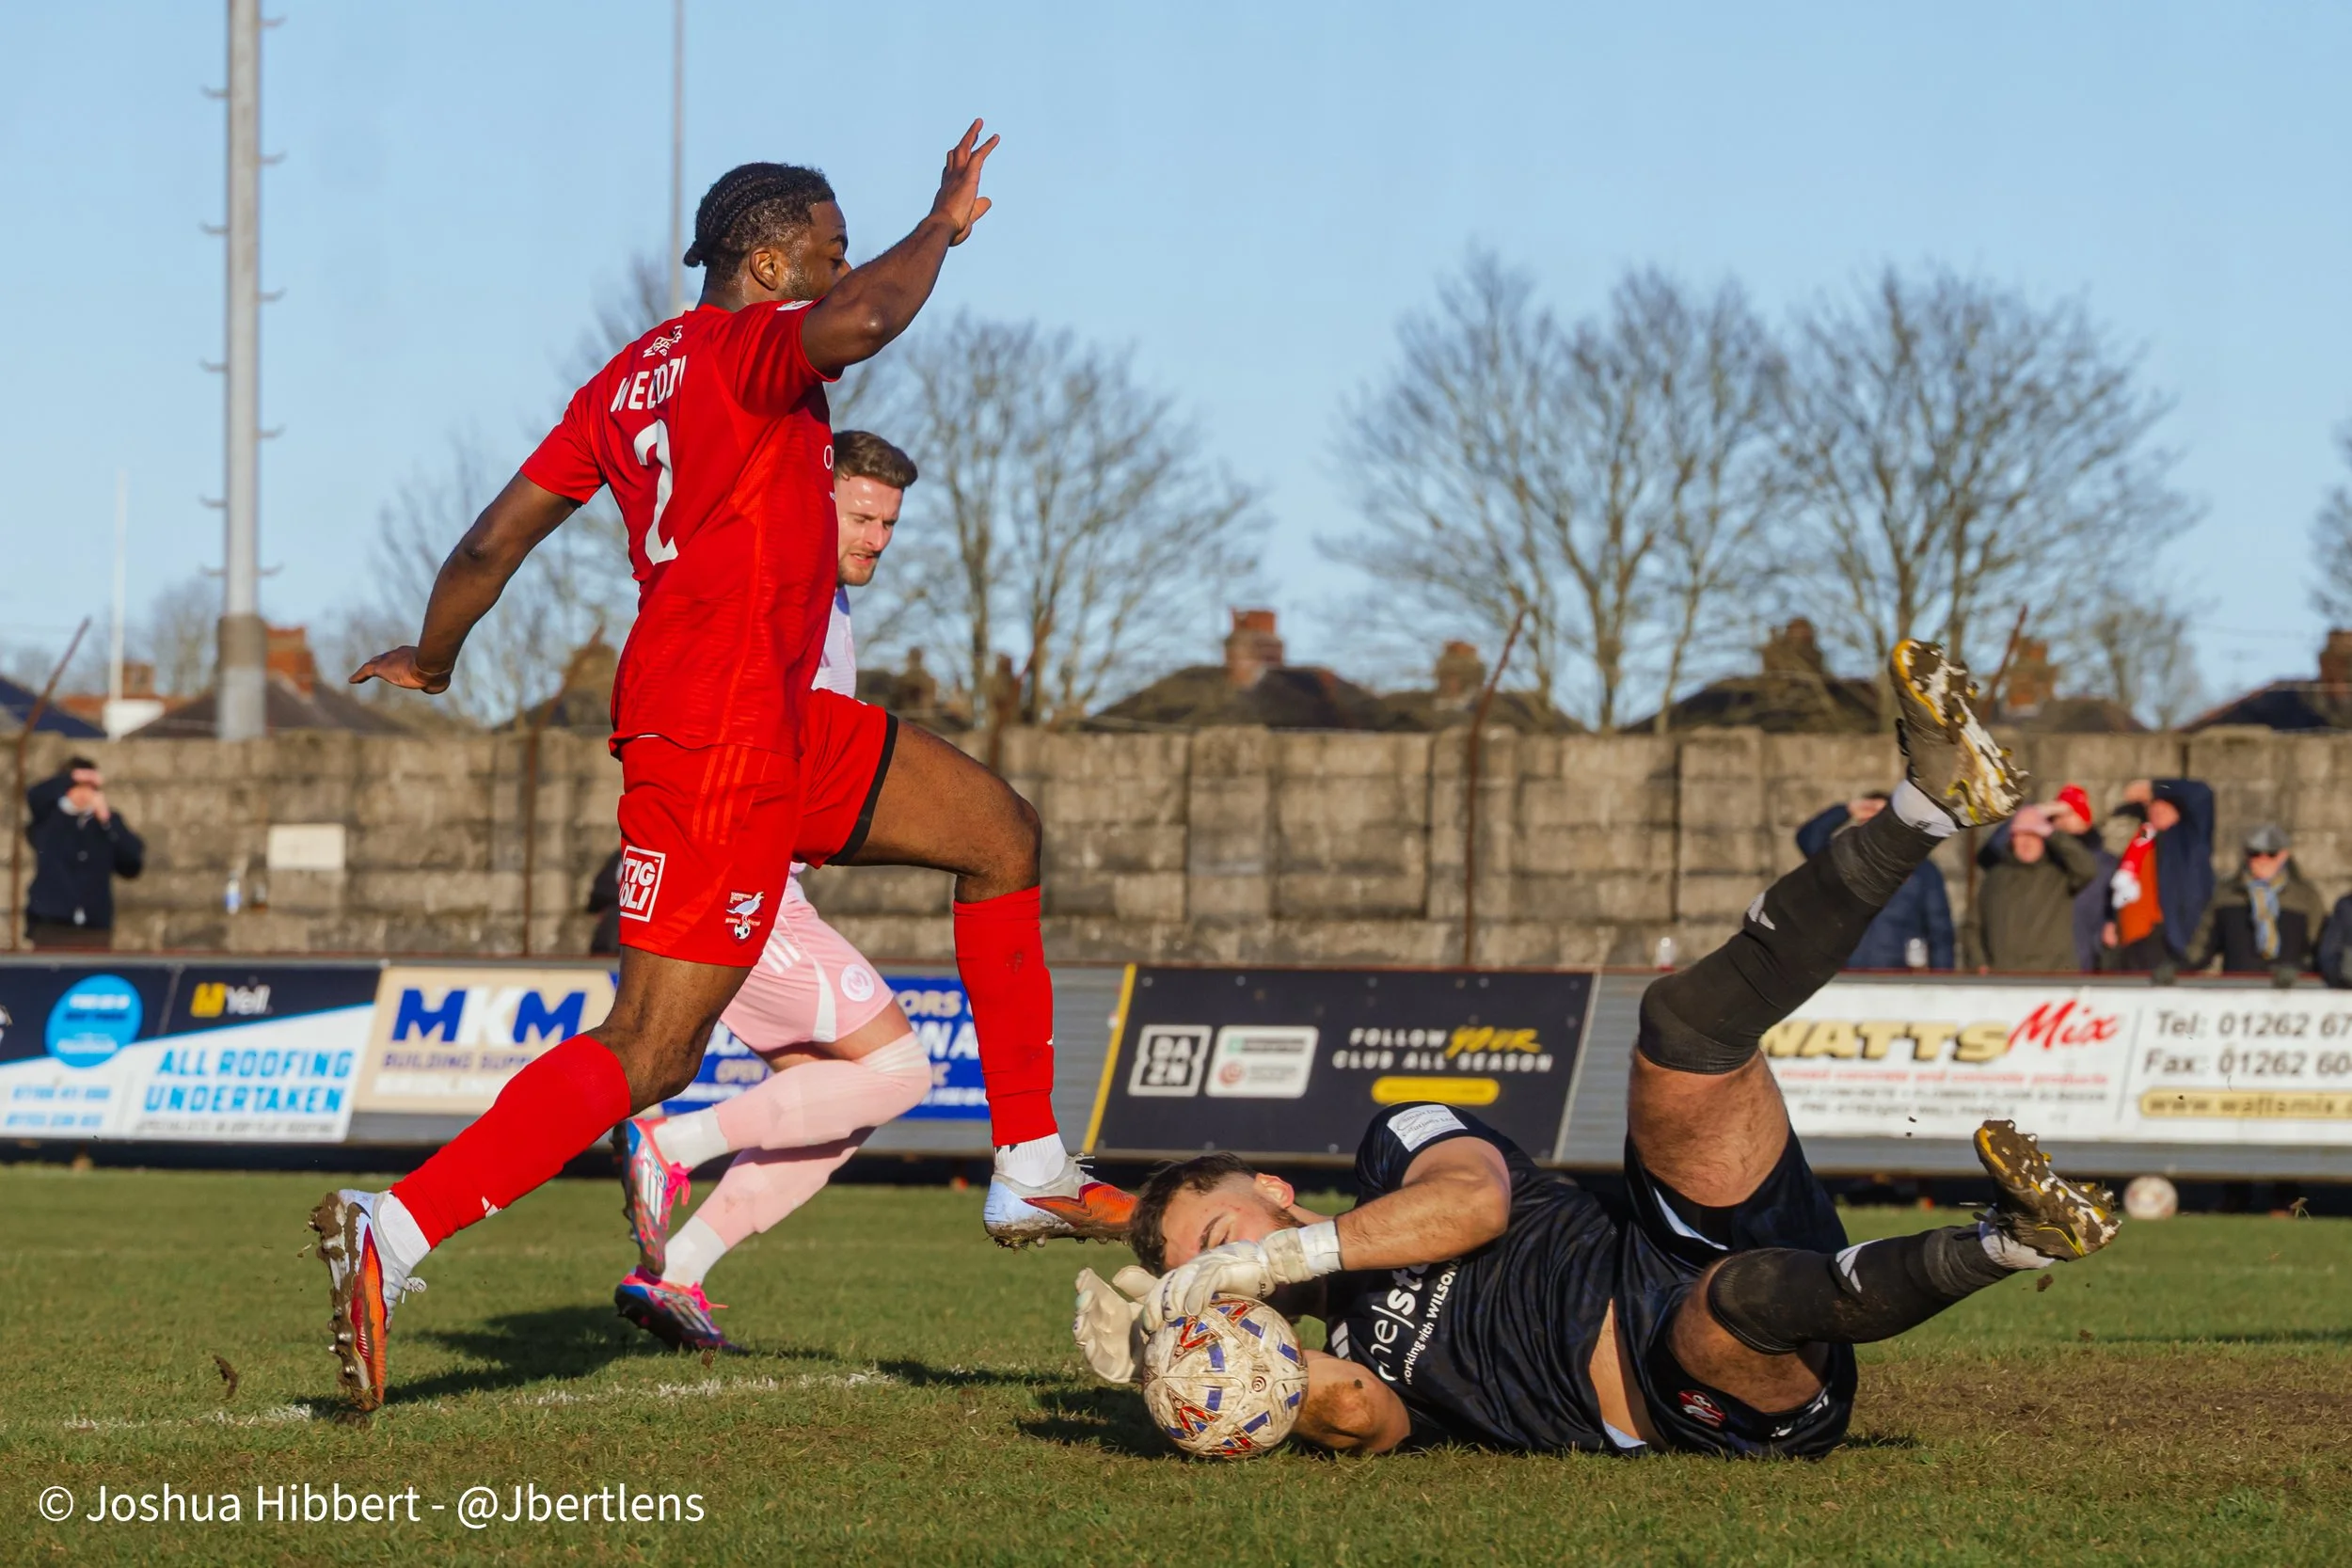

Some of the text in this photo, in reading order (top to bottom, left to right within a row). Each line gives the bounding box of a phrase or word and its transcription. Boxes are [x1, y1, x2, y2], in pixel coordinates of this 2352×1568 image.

[634, 420, 678, 565] 2
[391, 988, 587, 1048] MKM
[892, 990, 962, 1018] ORS
[1348, 1027, 1447, 1049] FOLLOW
[2007, 999, 2119, 1052] Mix
[2217, 1011, 2311, 1038] 01262
[156, 1048, 355, 1078] ALL ROOFING
[1457, 1052, 1554, 1073] SEASON
[2217, 1047, 2308, 1076] 01262
[144, 1084, 345, 1114] UNDERTAKEN
